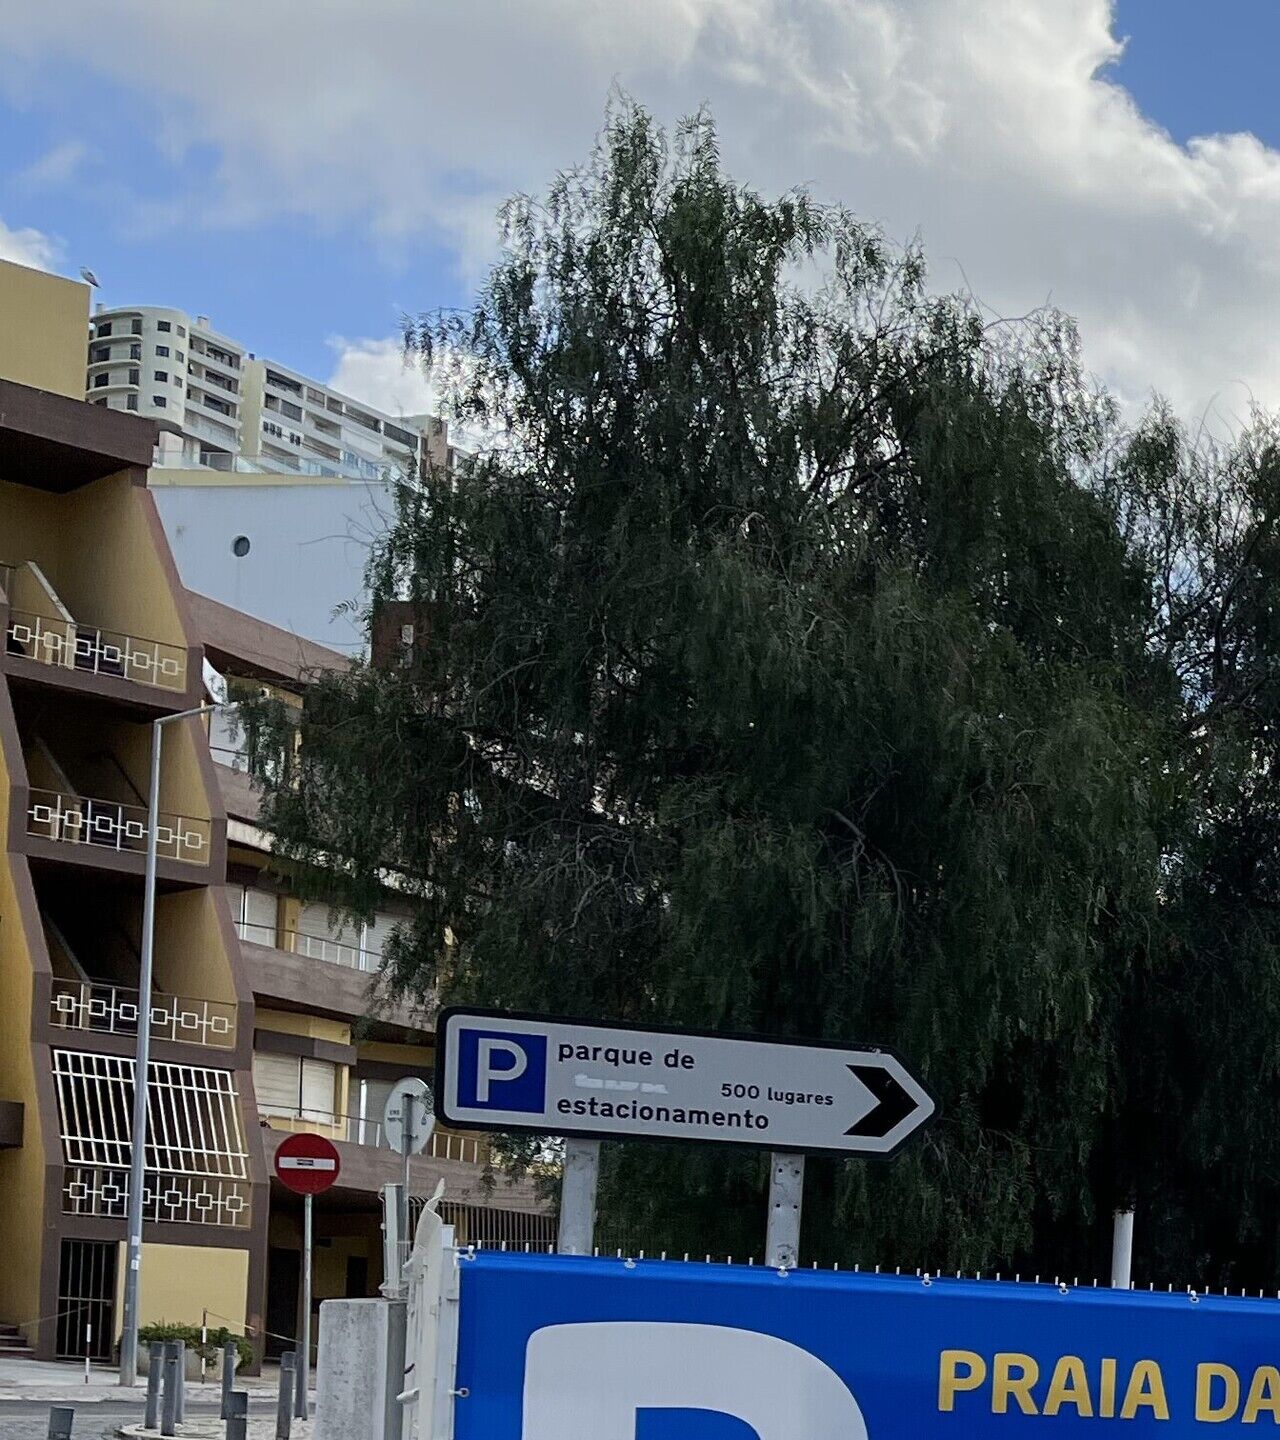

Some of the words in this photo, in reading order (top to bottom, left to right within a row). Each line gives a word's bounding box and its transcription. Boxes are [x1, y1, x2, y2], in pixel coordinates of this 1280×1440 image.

[476, 1037, 528, 1103] P
[558, 1043, 653, 1067] parque
[664, 1049, 695, 1069] de
[721, 1083, 760, 1099] 500
[767, 1087, 834, 1106] lugares
[557, 1097, 769, 1130] estacionamento
[938, 1350, 1170, 1420] PRAIA
